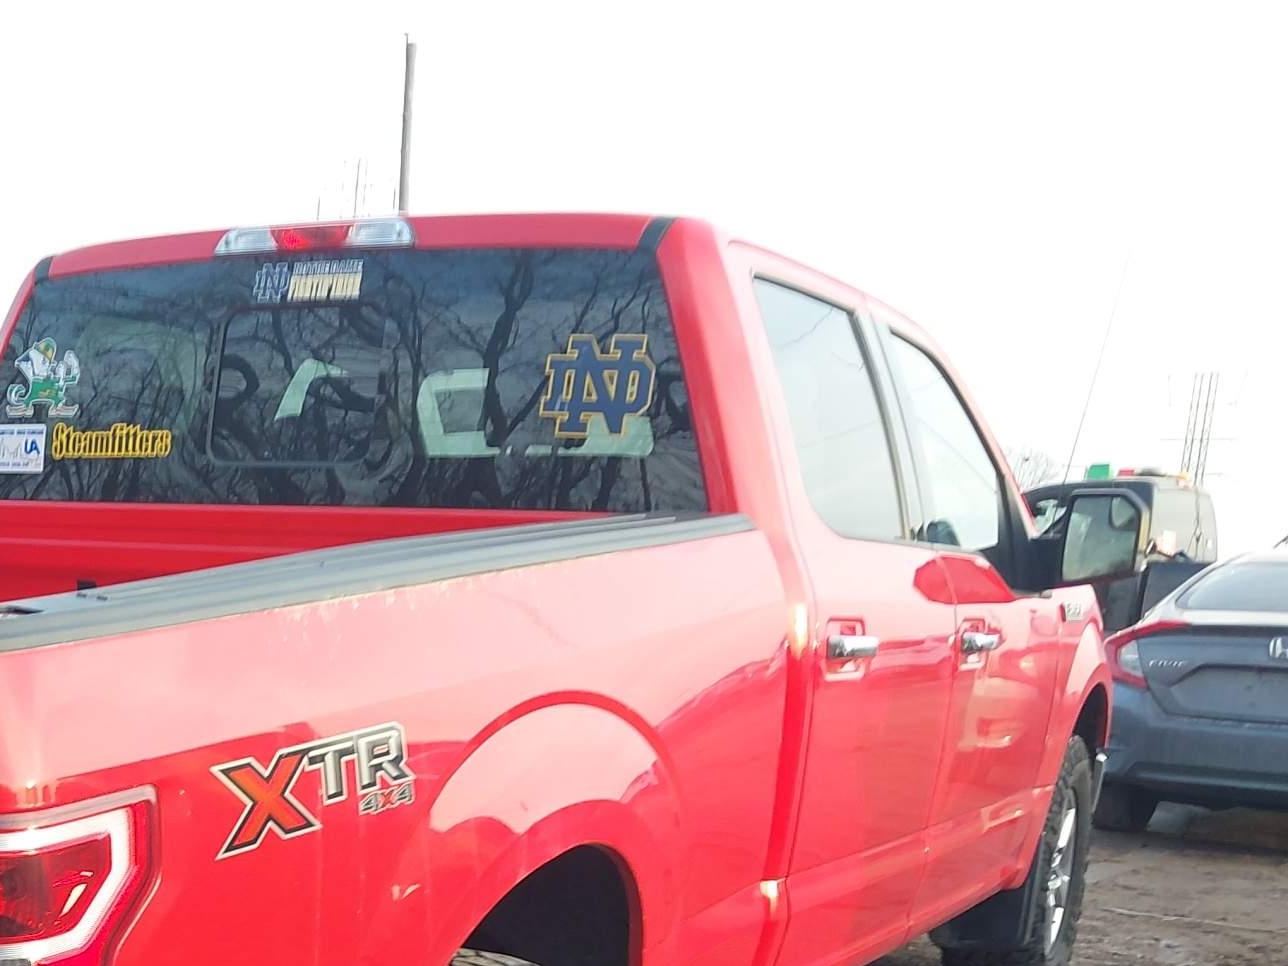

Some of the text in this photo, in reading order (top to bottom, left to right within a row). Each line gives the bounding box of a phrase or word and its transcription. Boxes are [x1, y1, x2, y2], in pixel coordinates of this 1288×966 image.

[539, 334, 656, 438] ND
[52, 422, 171, 460] Steamfitters
[209, 721, 417, 861] XTR
